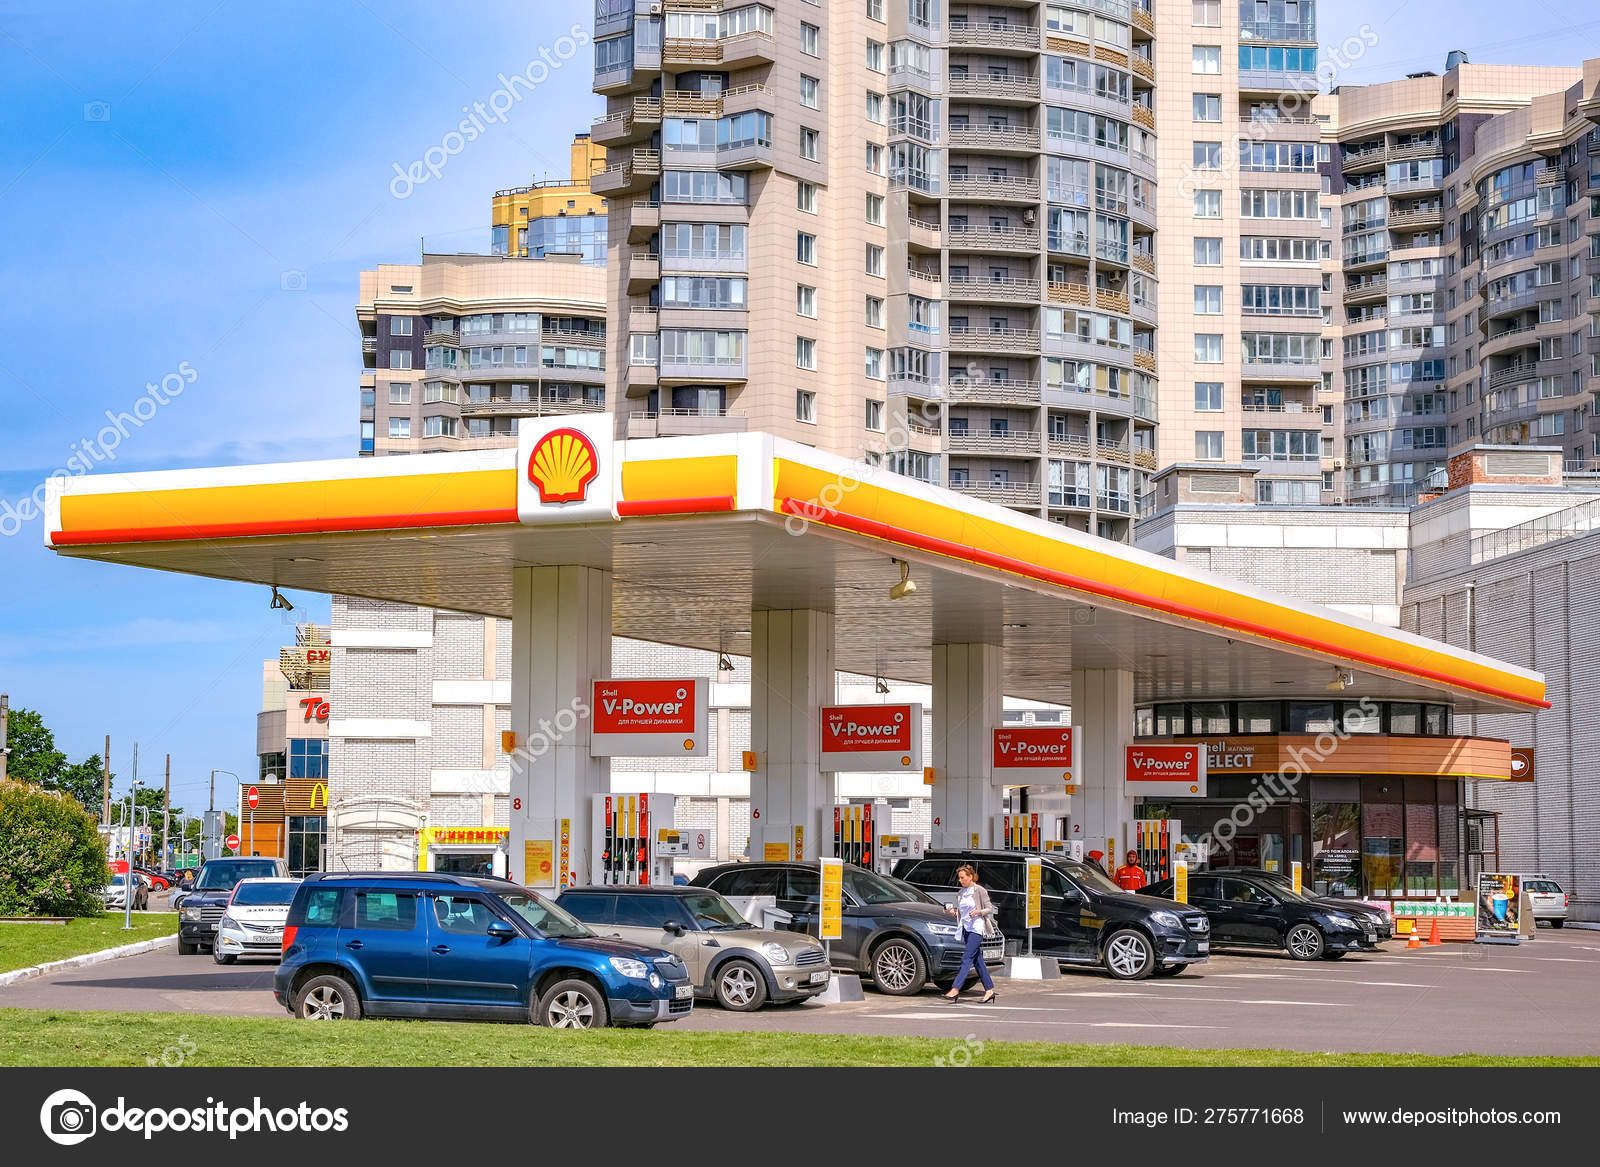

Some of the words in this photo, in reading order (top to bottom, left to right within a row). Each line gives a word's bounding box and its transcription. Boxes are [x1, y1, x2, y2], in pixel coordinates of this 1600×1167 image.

[307, 650, 331, 661] БУ
[602, 689, 618, 697] Shell
[602, 699, 683, 715] V-Power
[830, 722, 900, 737] V-Power
[999, 742, 1067, 754] V-Power
[1200, 742, 1225, 752] hell
[1132, 758, 1190, 770] V-Power
[1207, 754, 1254, 768] ELECT
[513, 798, 521, 810] 8
[753, 808, 760, 819] 6
[934, 817, 941, 826] 4
[1074, 824, 1080, 833] 2
